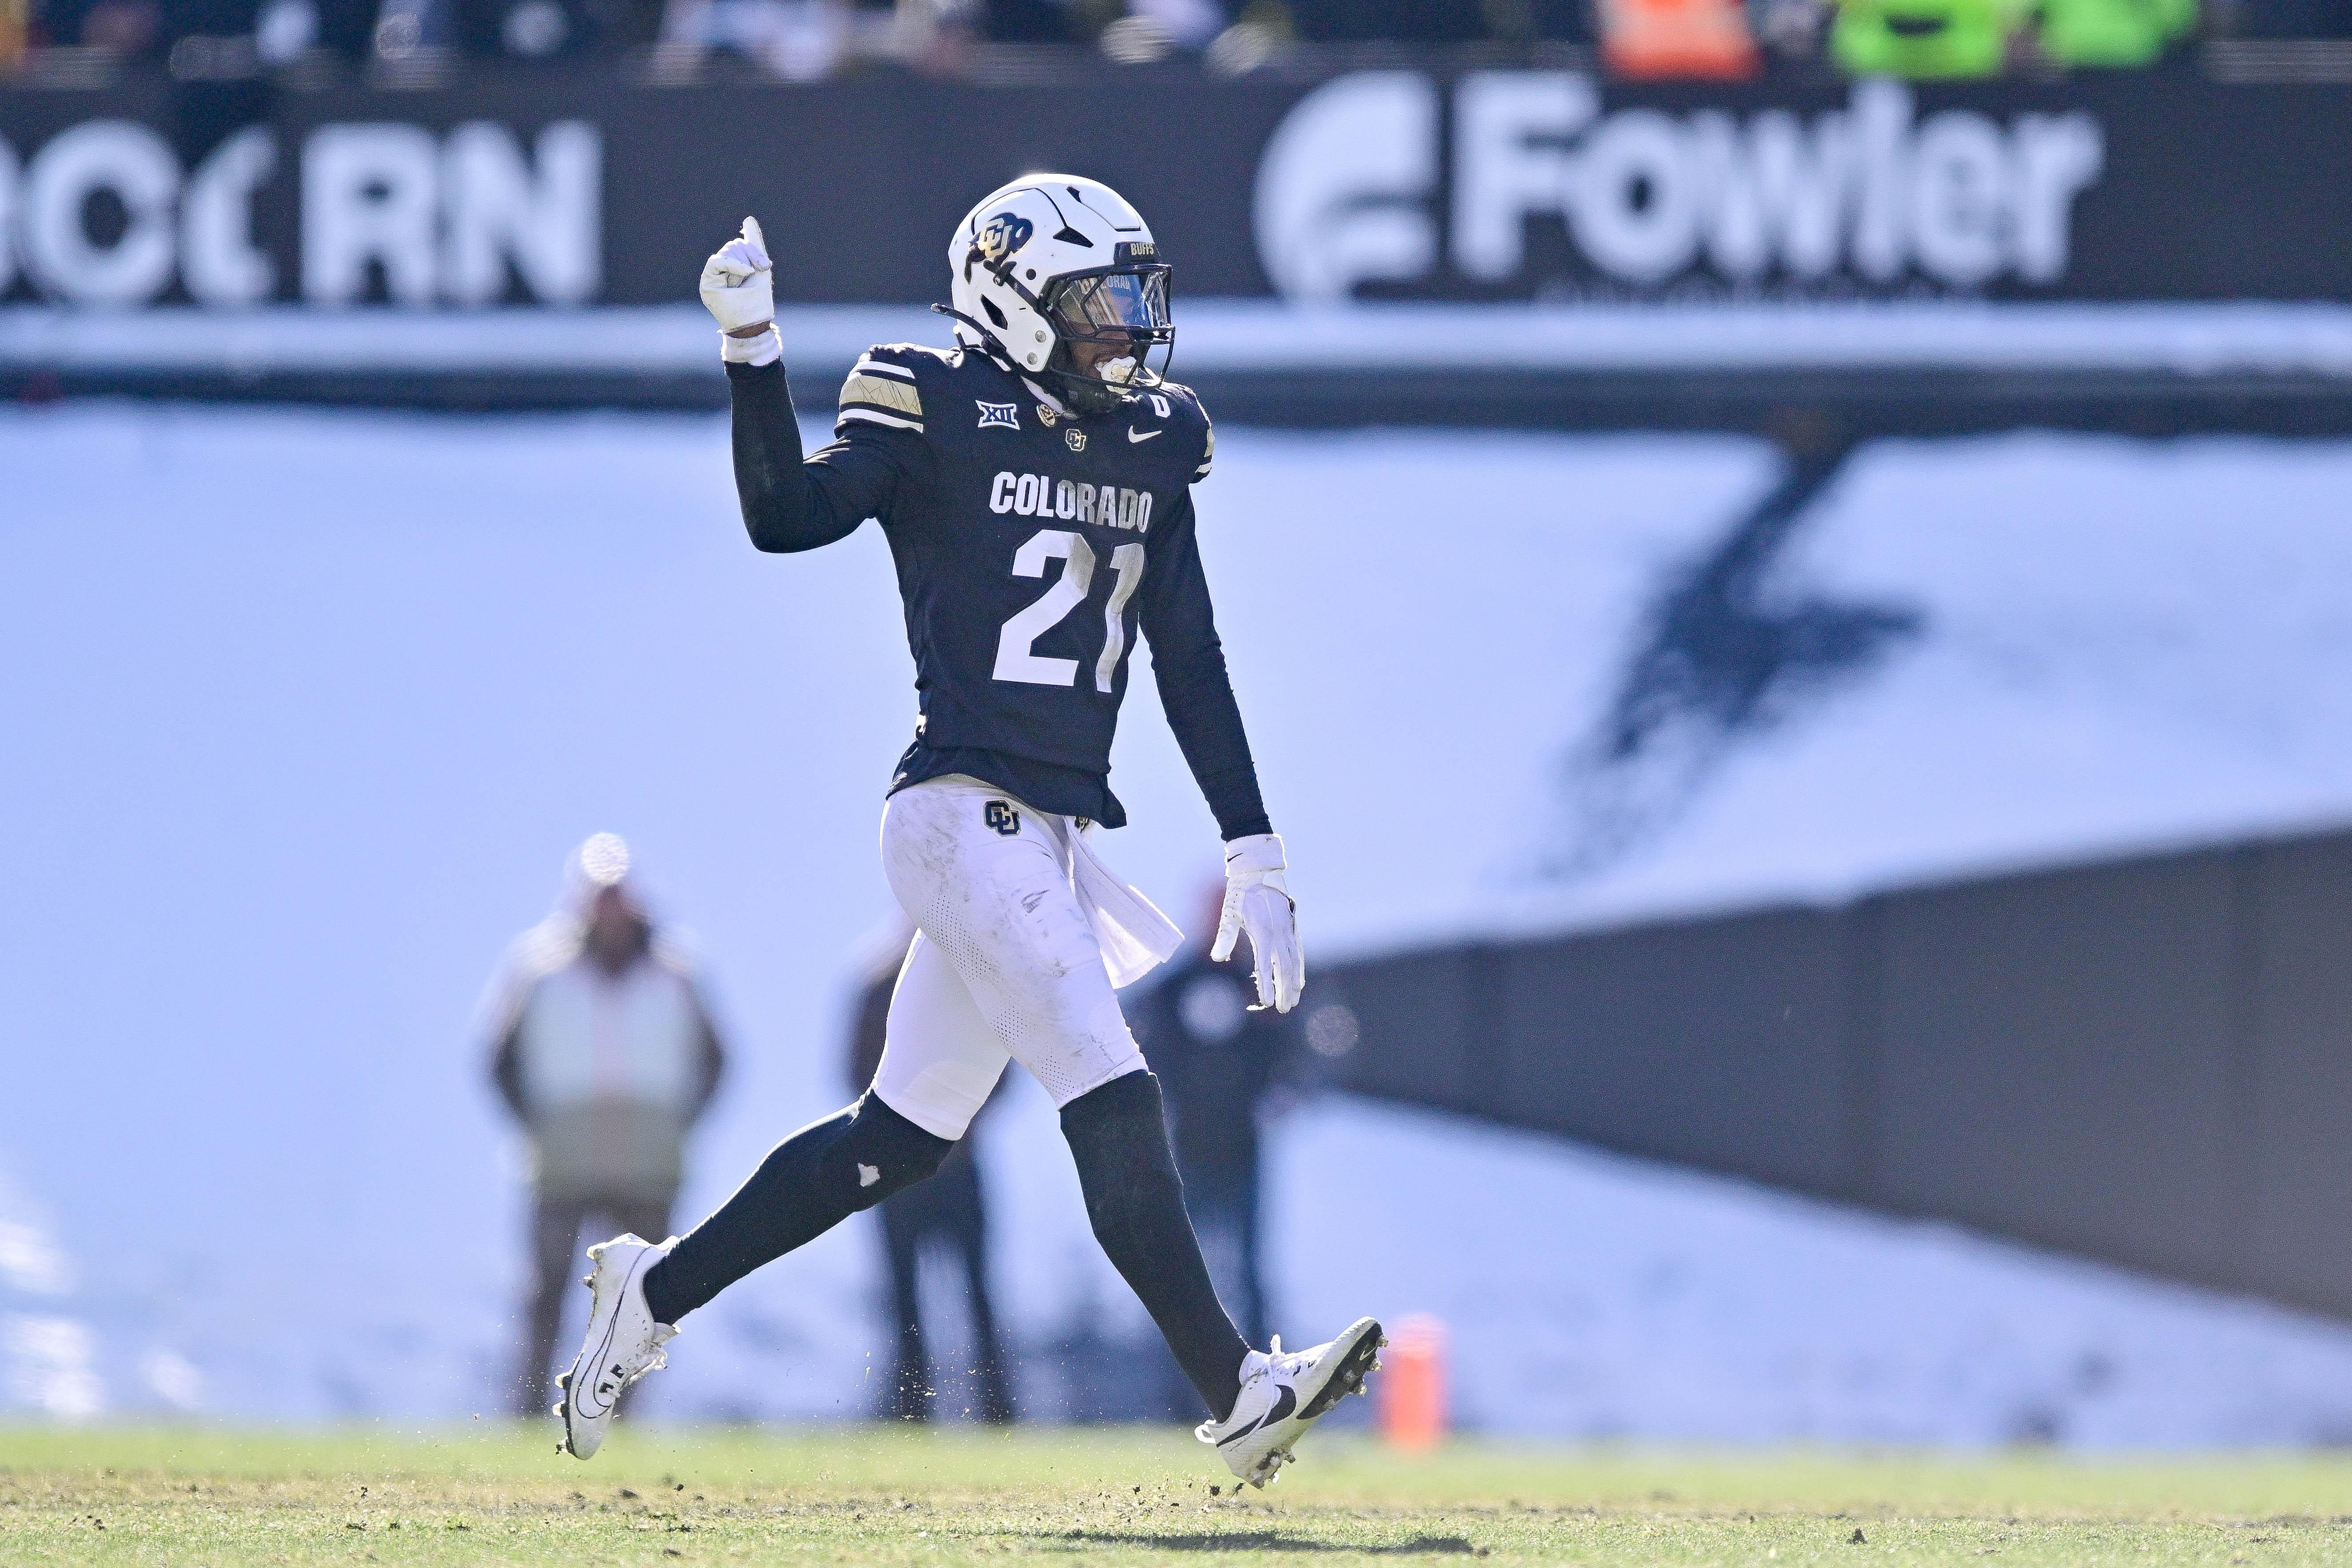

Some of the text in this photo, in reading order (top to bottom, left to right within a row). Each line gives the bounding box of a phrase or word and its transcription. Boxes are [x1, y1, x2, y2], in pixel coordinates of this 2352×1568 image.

[1454, 72, 2105, 284] Fowler
[978, 217, 1013, 259] CU
[1130, 243, 1154, 255] BUFFS
[980, 403, 1017, 426] XII
[1065, 428, 1087, 451] CU
[989, 471, 1152, 533] COLORADO
[992, 529, 1144, 693] 21
[983, 800, 1021, 836] CU
